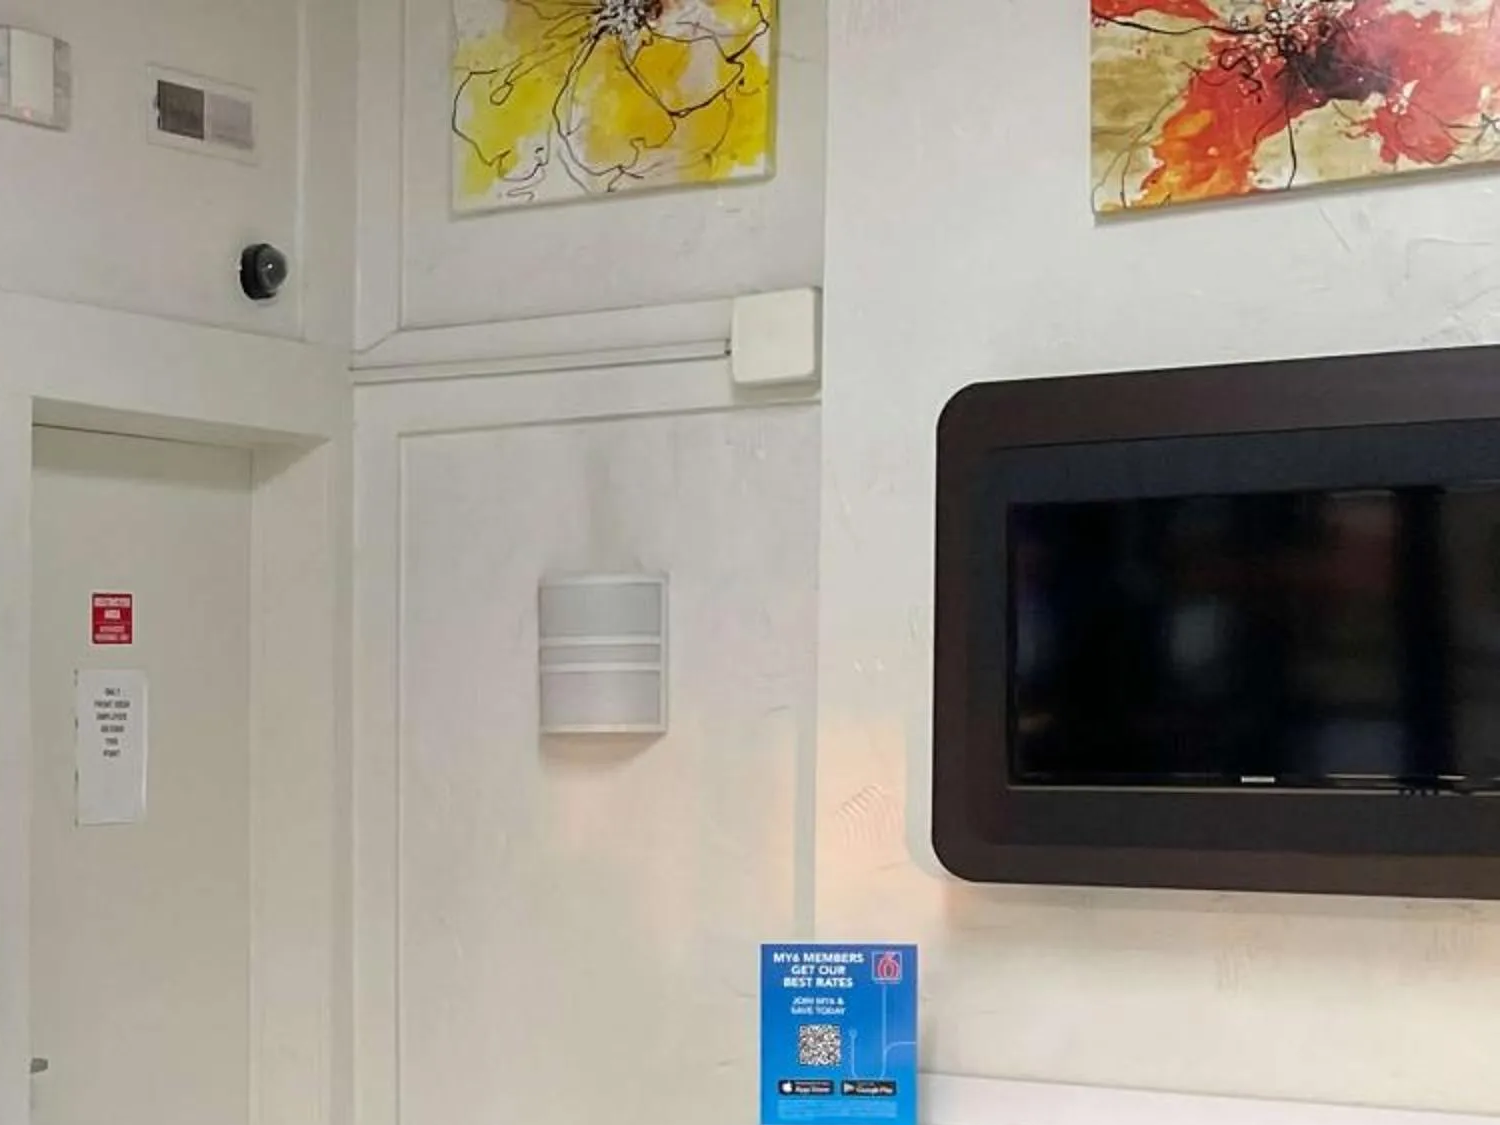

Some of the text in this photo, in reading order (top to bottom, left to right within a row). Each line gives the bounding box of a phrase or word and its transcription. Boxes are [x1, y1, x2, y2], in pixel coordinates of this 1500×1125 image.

[773, 952, 865, 964] MY6 MEMBERS
[791, 965, 846, 975] GET OUR
[783, 977, 854, 988] BEST RATES
